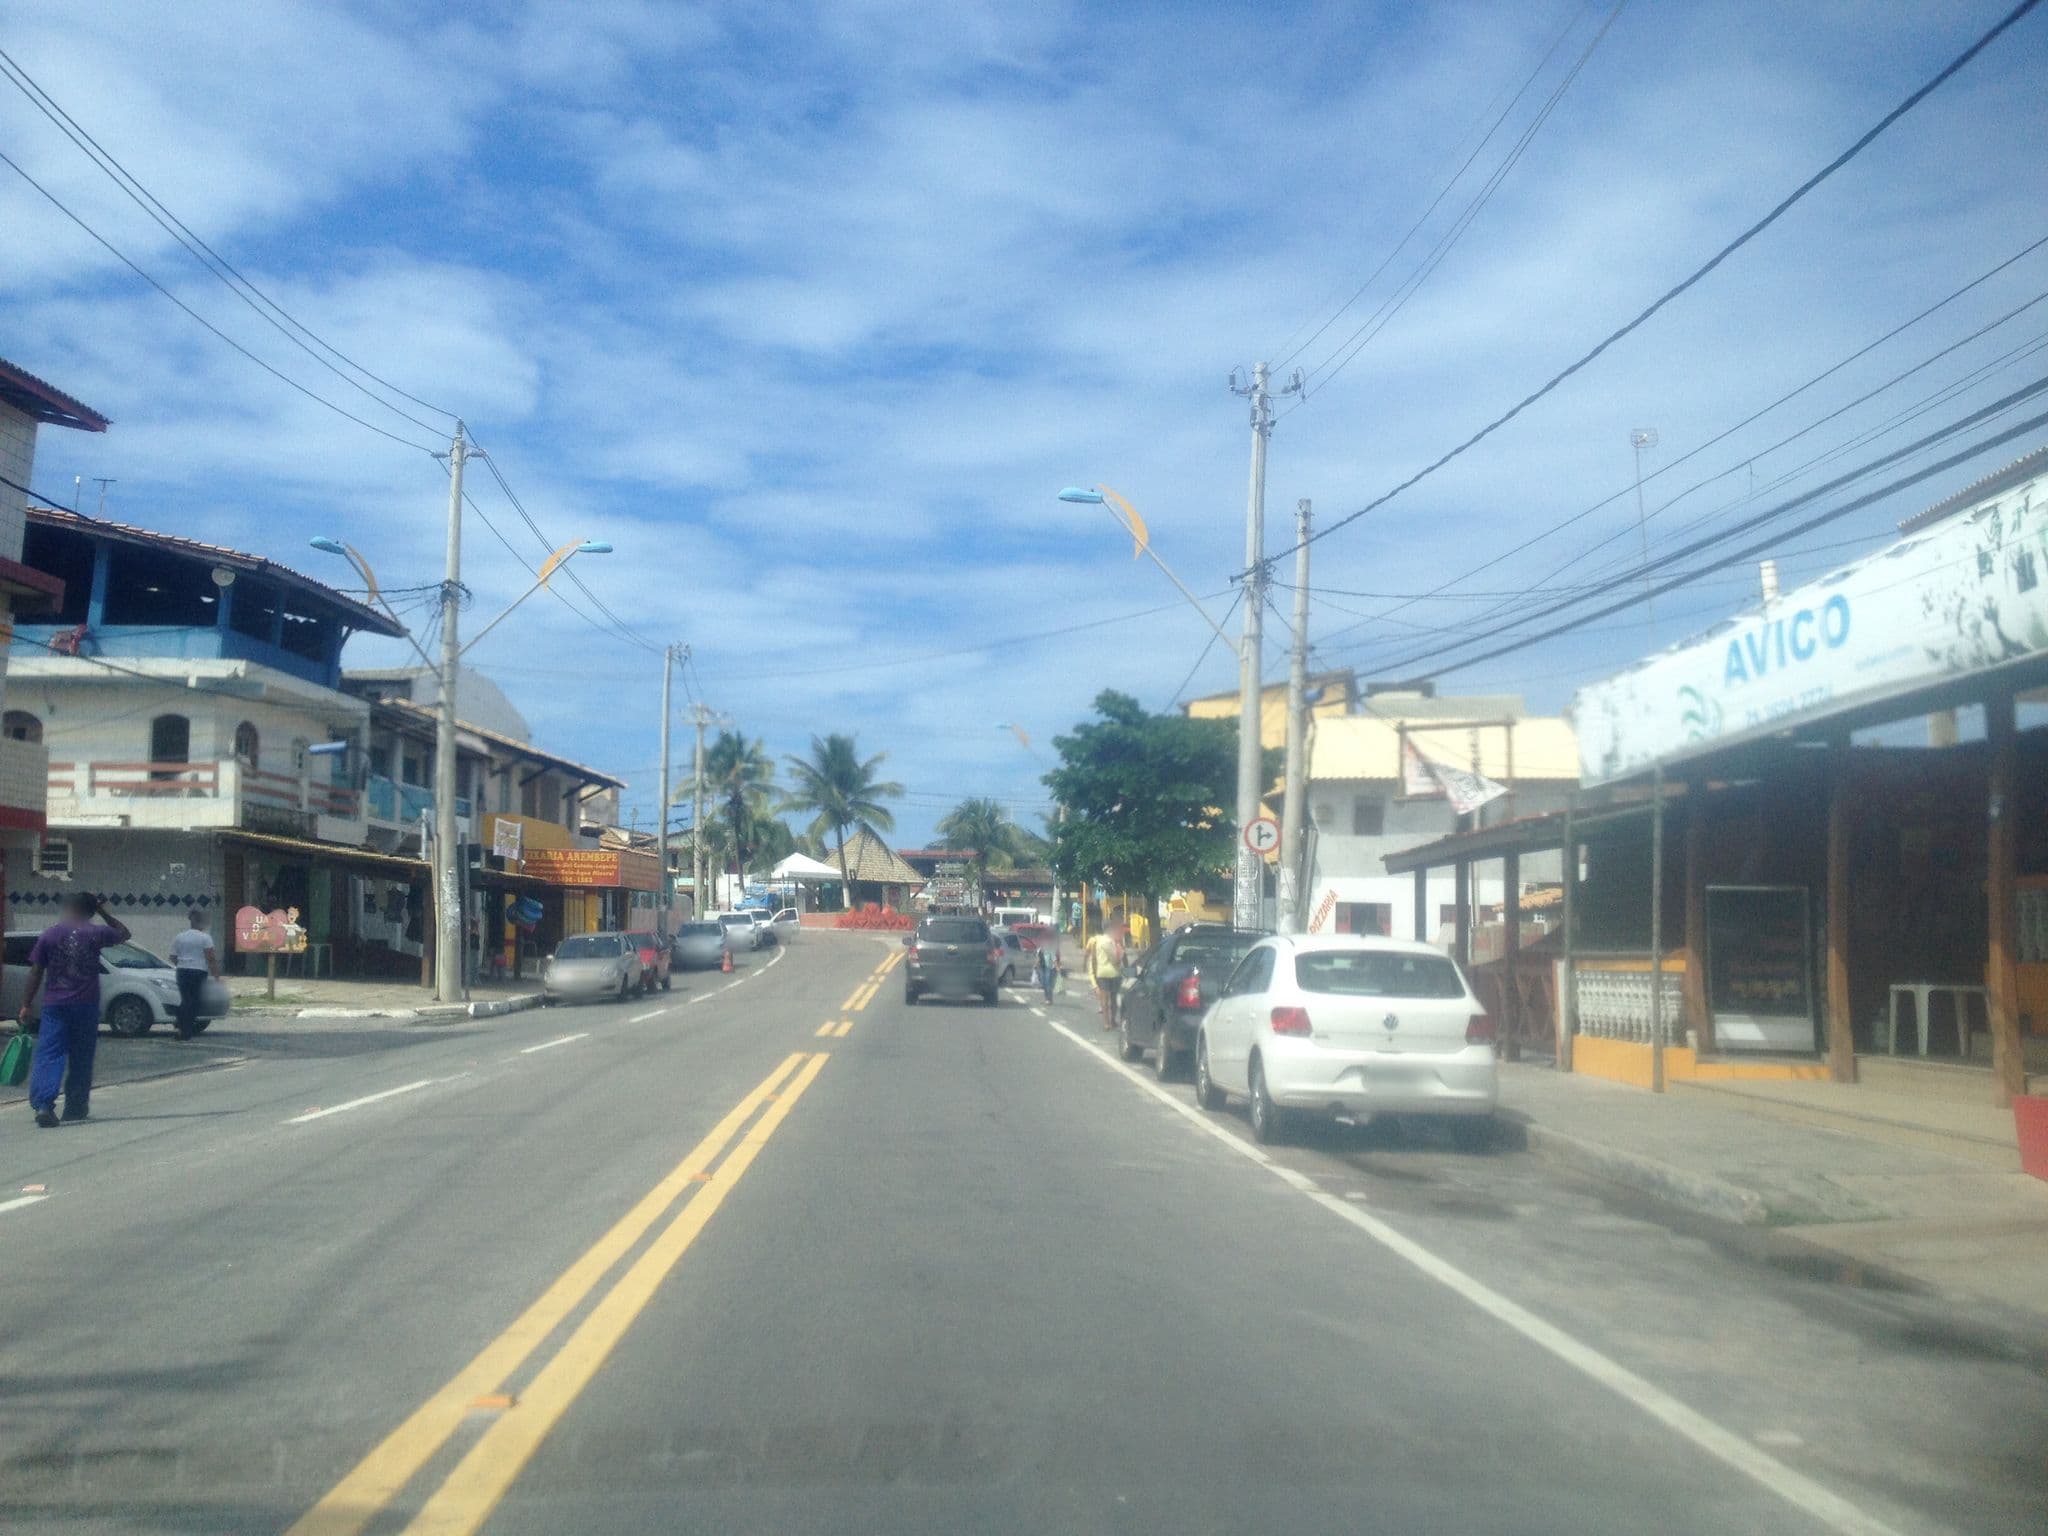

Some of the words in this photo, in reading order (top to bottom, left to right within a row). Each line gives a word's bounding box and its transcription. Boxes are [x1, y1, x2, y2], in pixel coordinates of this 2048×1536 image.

[1725, 594, 1850, 688] AVICO
[567, 852, 618, 862] AREMBEPE
[1309, 889, 1337, 935] PIZZARIA
